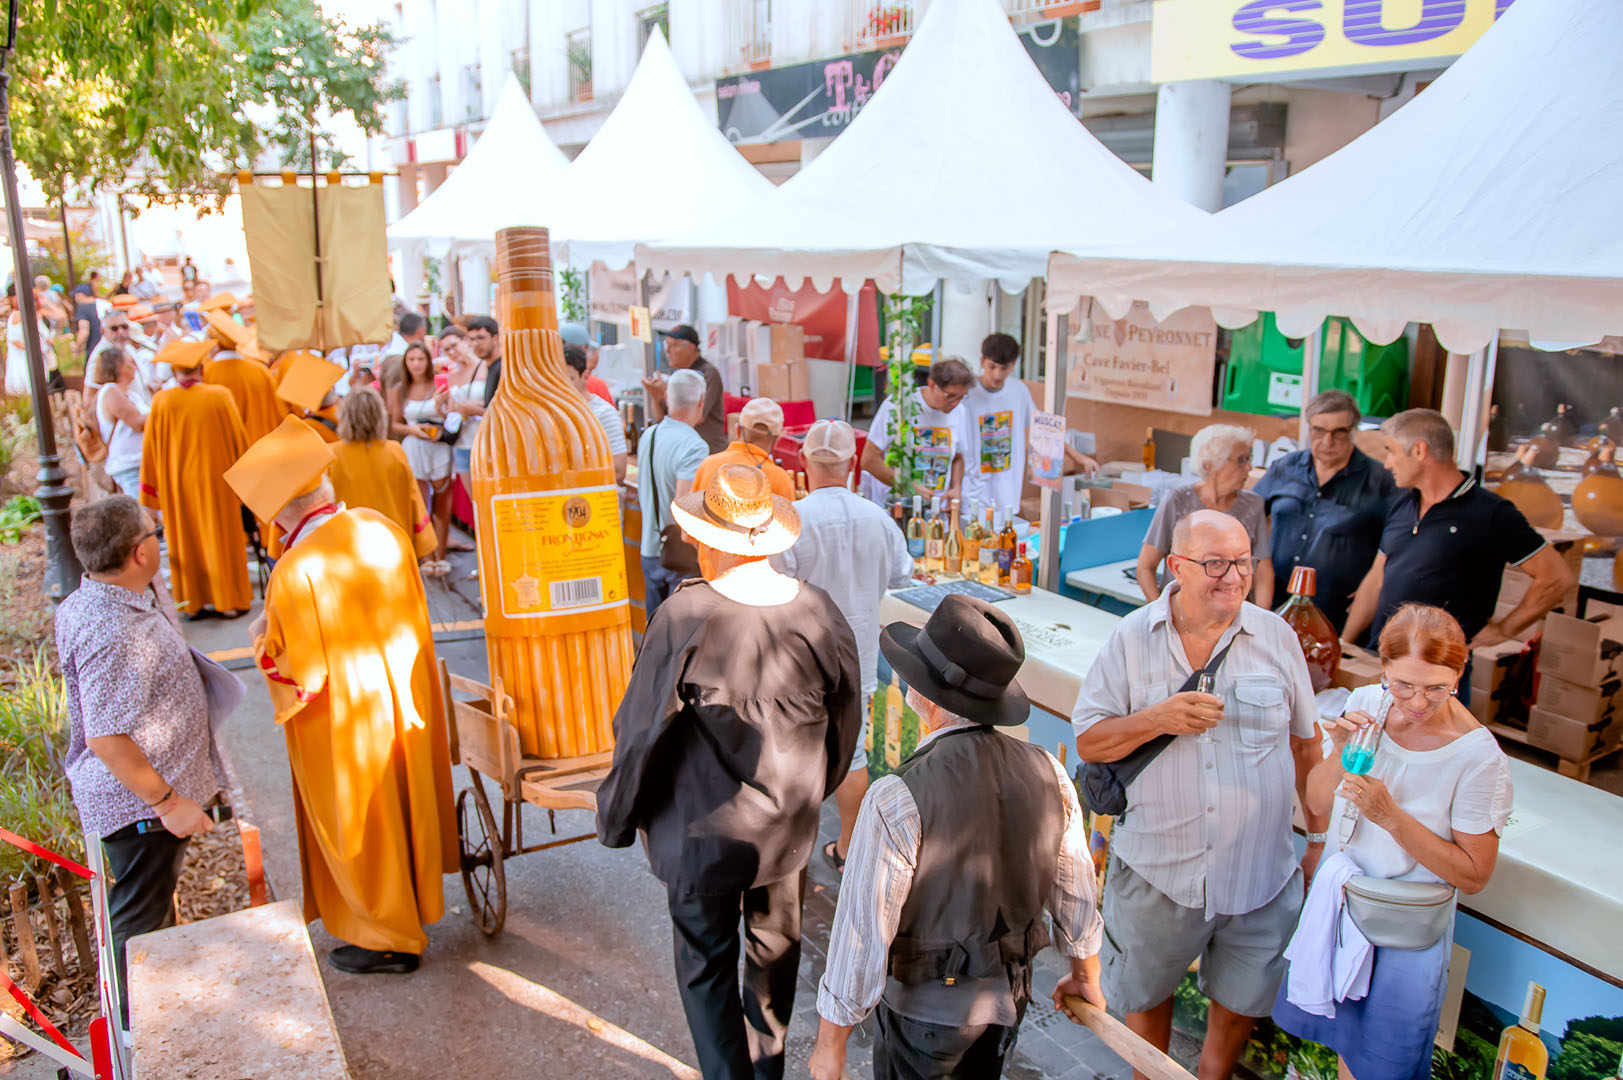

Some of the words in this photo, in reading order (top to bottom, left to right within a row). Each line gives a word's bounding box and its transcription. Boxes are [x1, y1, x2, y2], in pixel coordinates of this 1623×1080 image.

[1230, 0, 1514, 60] SU
[1129, 324, 1212, 347] PEYRONNET
[1083, 352, 1110, 368] Cave
[1034, 415, 1061, 428] MUSCAT
